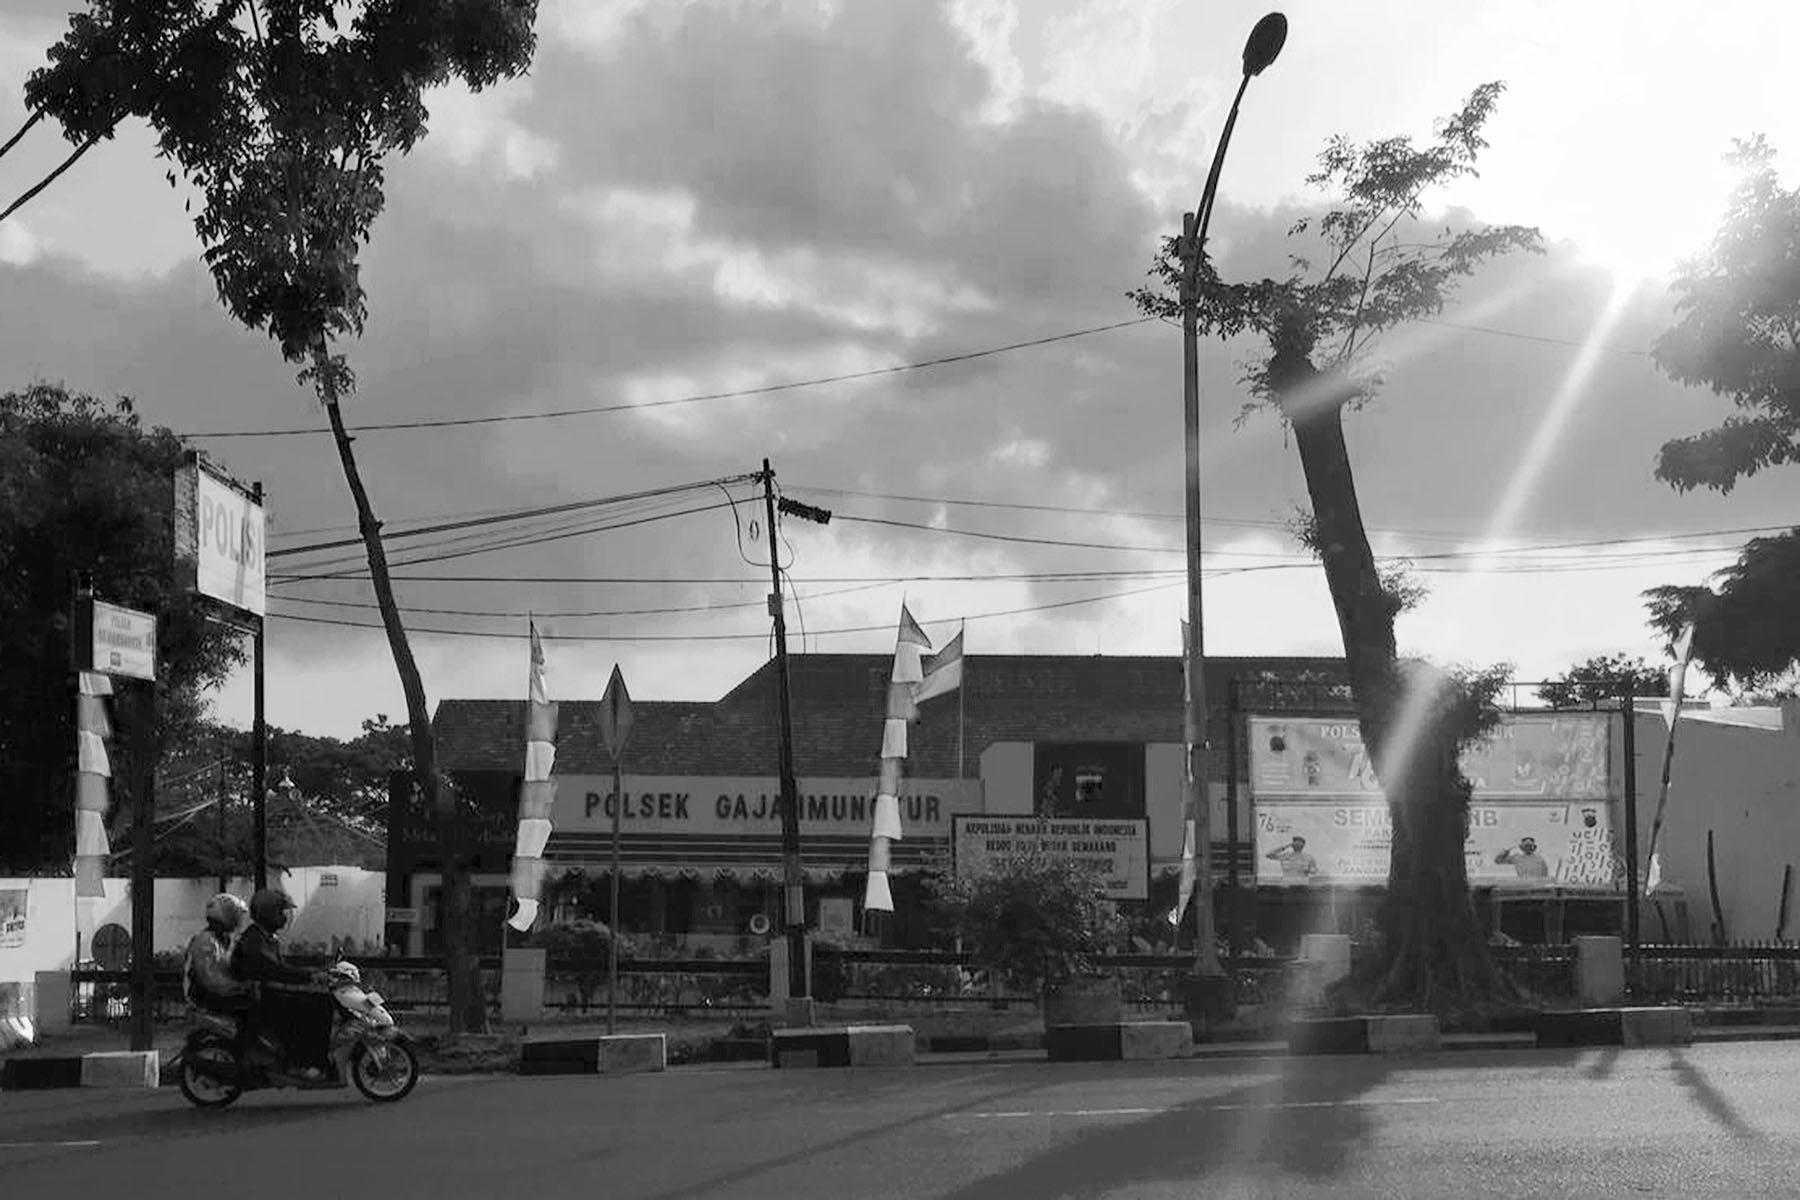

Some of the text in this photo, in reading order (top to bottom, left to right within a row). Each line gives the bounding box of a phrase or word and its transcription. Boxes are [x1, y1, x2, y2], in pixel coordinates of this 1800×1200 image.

[1321, 725, 1361, 738] POLS
[585, 792, 940, 821] POLSEK GAJAMUNUR
